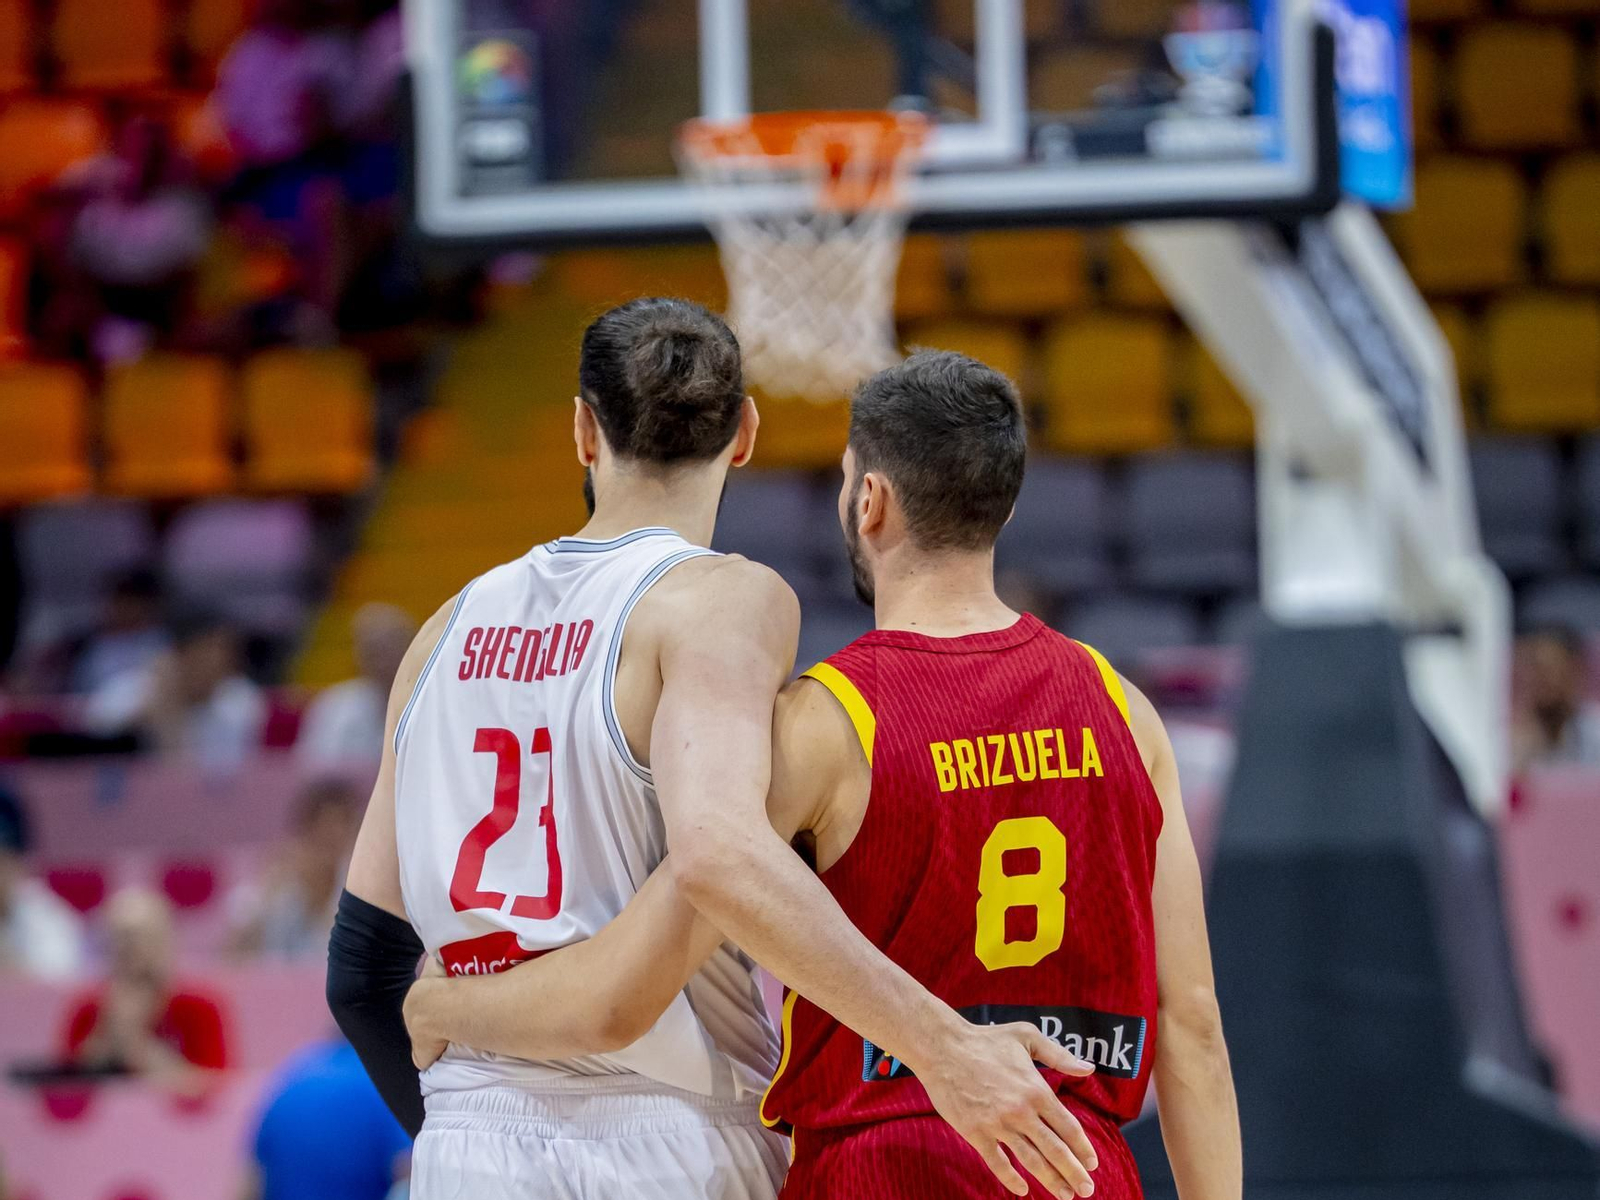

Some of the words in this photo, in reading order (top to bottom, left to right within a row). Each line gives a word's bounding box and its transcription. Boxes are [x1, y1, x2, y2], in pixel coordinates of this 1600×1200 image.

[929, 727, 1104, 793] BRIZUELA
[449, 727, 563, 921] 23
[974, 815, 1067, 972] 8
[1039, 1015, 1135, 1071] Bank
